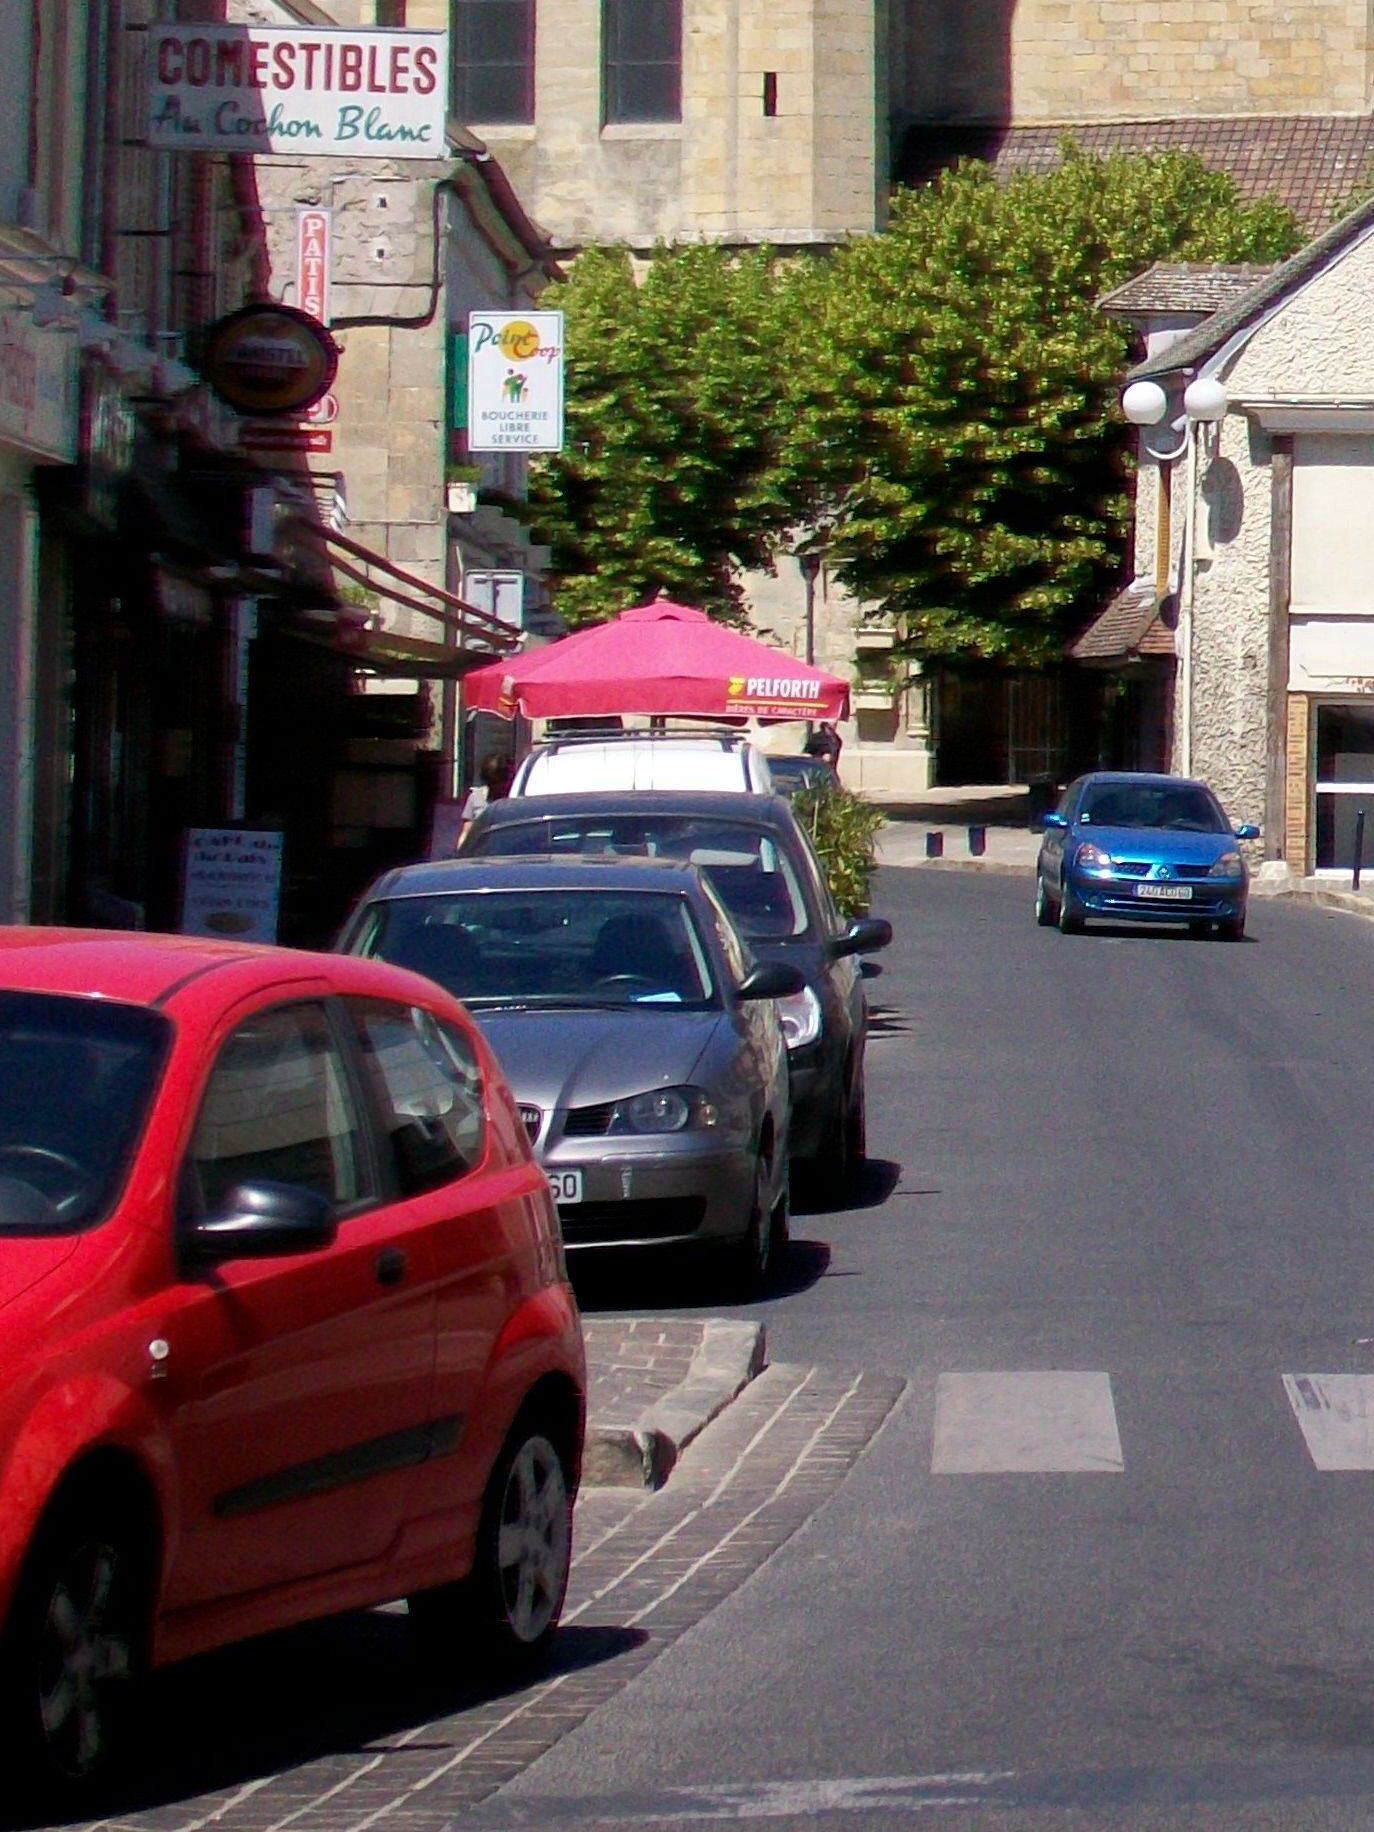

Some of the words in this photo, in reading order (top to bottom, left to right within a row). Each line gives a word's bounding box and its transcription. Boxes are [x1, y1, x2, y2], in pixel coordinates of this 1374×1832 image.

[157, 36, 437, 94] COMESTIBLES
[154, 94, 202, 136] Au
[214, 100, 322, 137] Cochon
[333, 104, 432, 143] Blanc
[471, 323, 532, 353] Point
[481, 411, 548, 421] BOUCHERIE
[500, 423, 530, 432] LIBRE
[491, 434, 539, 444] SERVICE
[746, 677, 820, 699] PELFORTH
